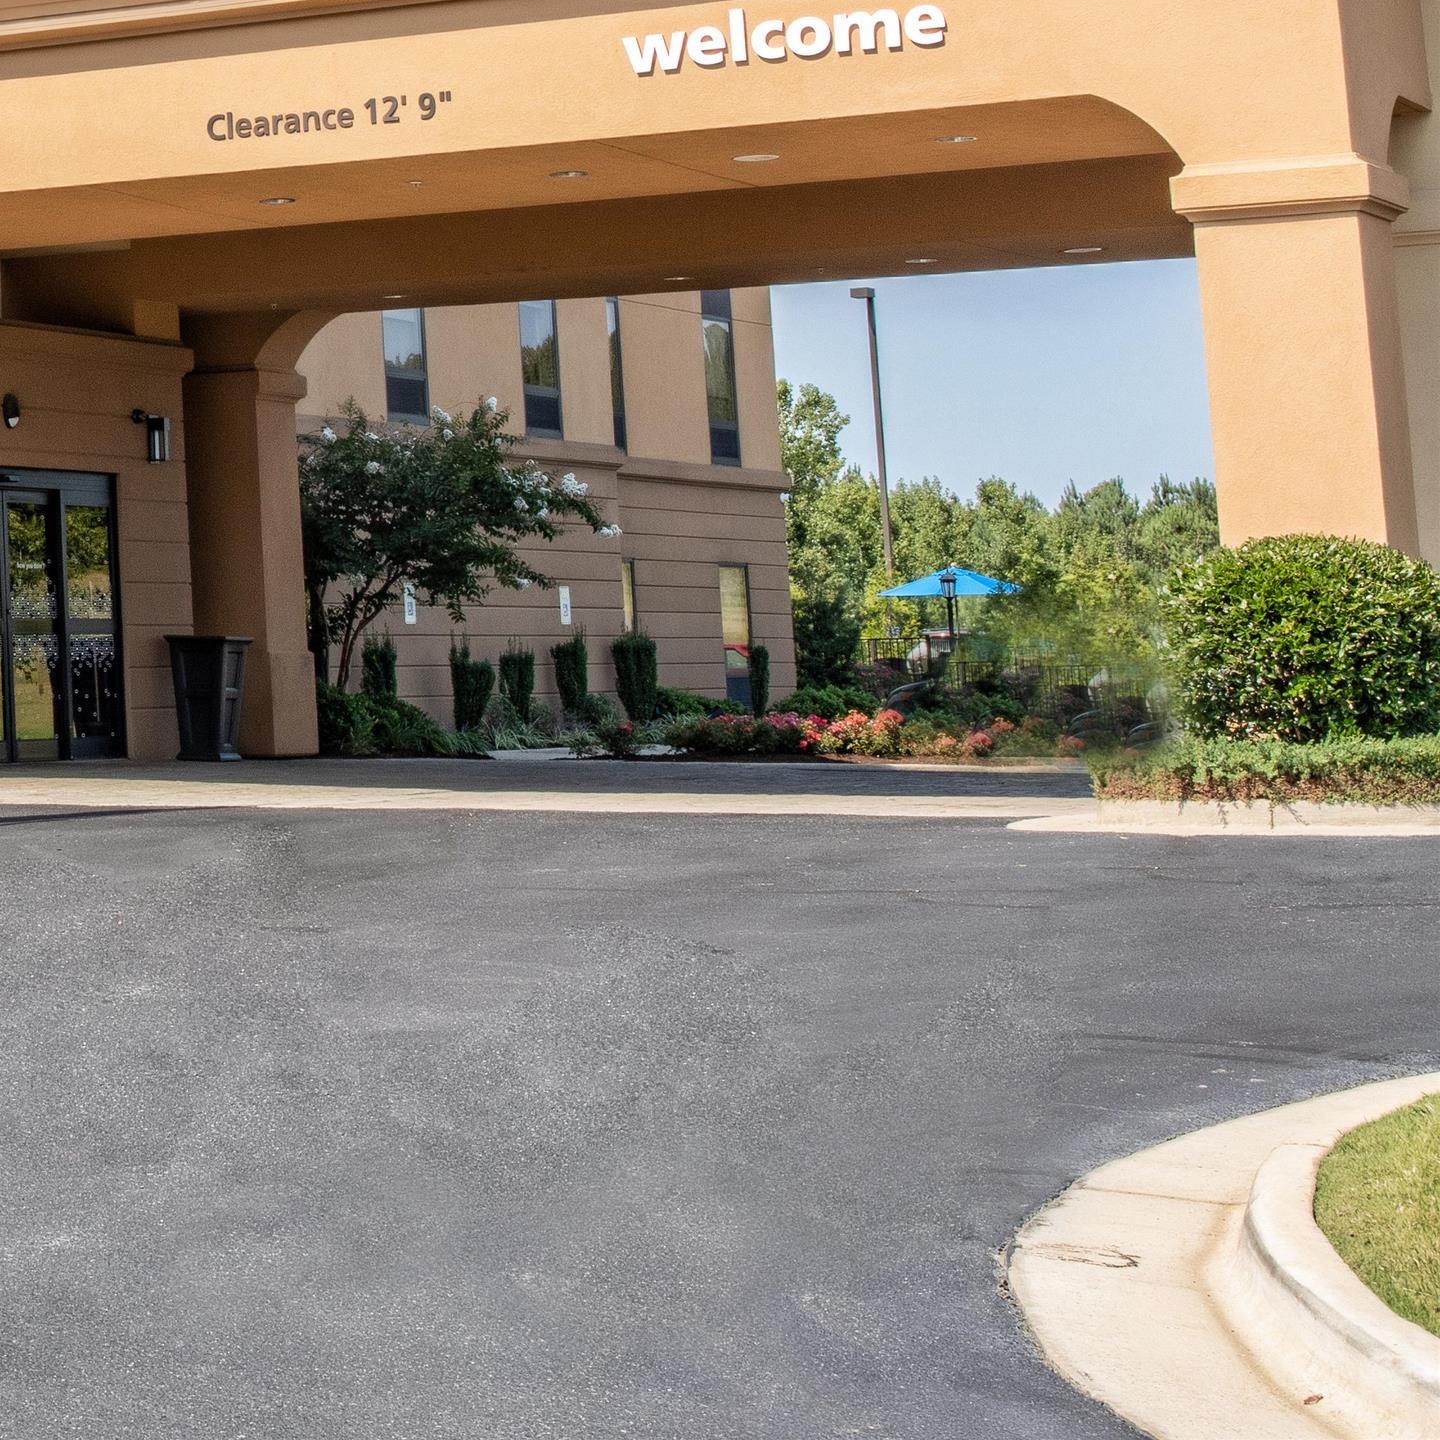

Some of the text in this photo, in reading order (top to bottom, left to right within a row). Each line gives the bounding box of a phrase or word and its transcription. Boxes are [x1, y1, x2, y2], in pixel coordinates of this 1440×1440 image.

[621, 4, 947, 76] welcome
[207, 90, 452, 141] Clearance 12' 9"
